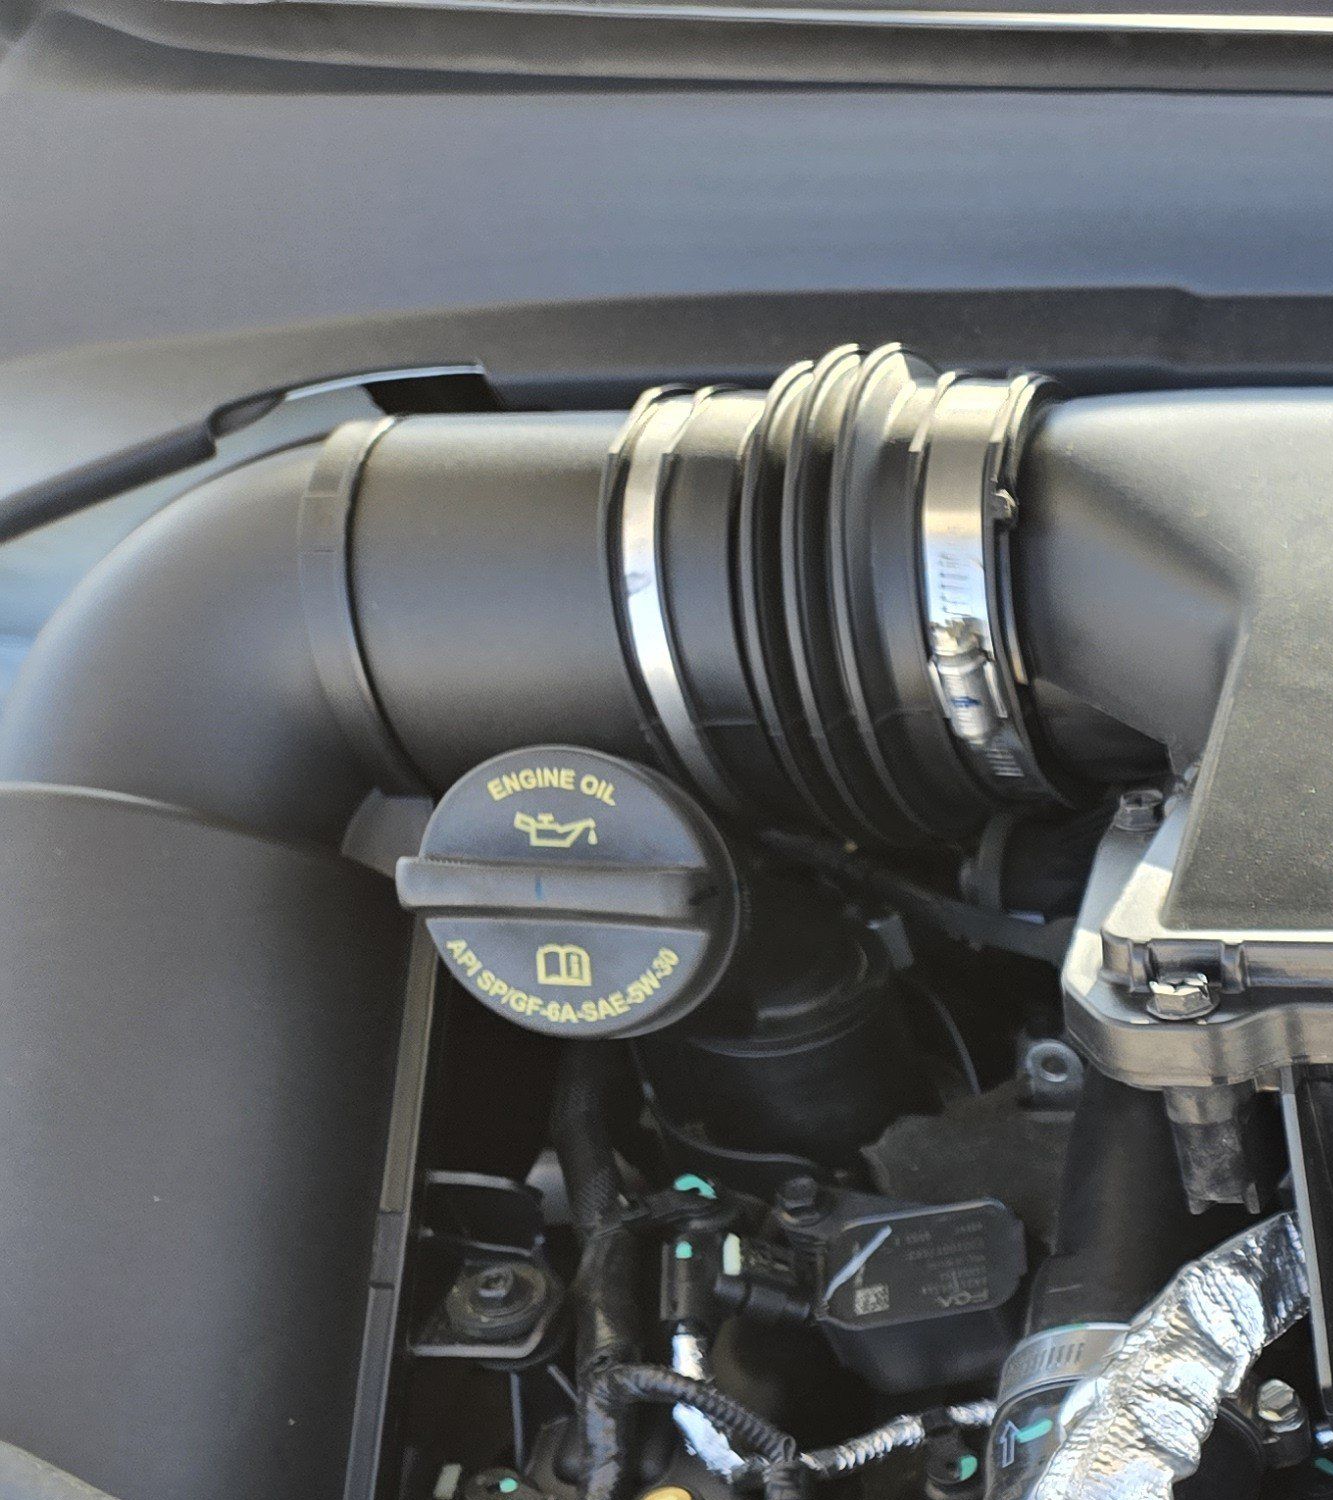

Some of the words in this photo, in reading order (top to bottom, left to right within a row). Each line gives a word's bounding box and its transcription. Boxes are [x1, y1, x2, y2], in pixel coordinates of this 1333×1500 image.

[487, 767, 575, 801] ENGINE
[580, 774, 616, 806] OIL
[446, 939, 481, 976] API
